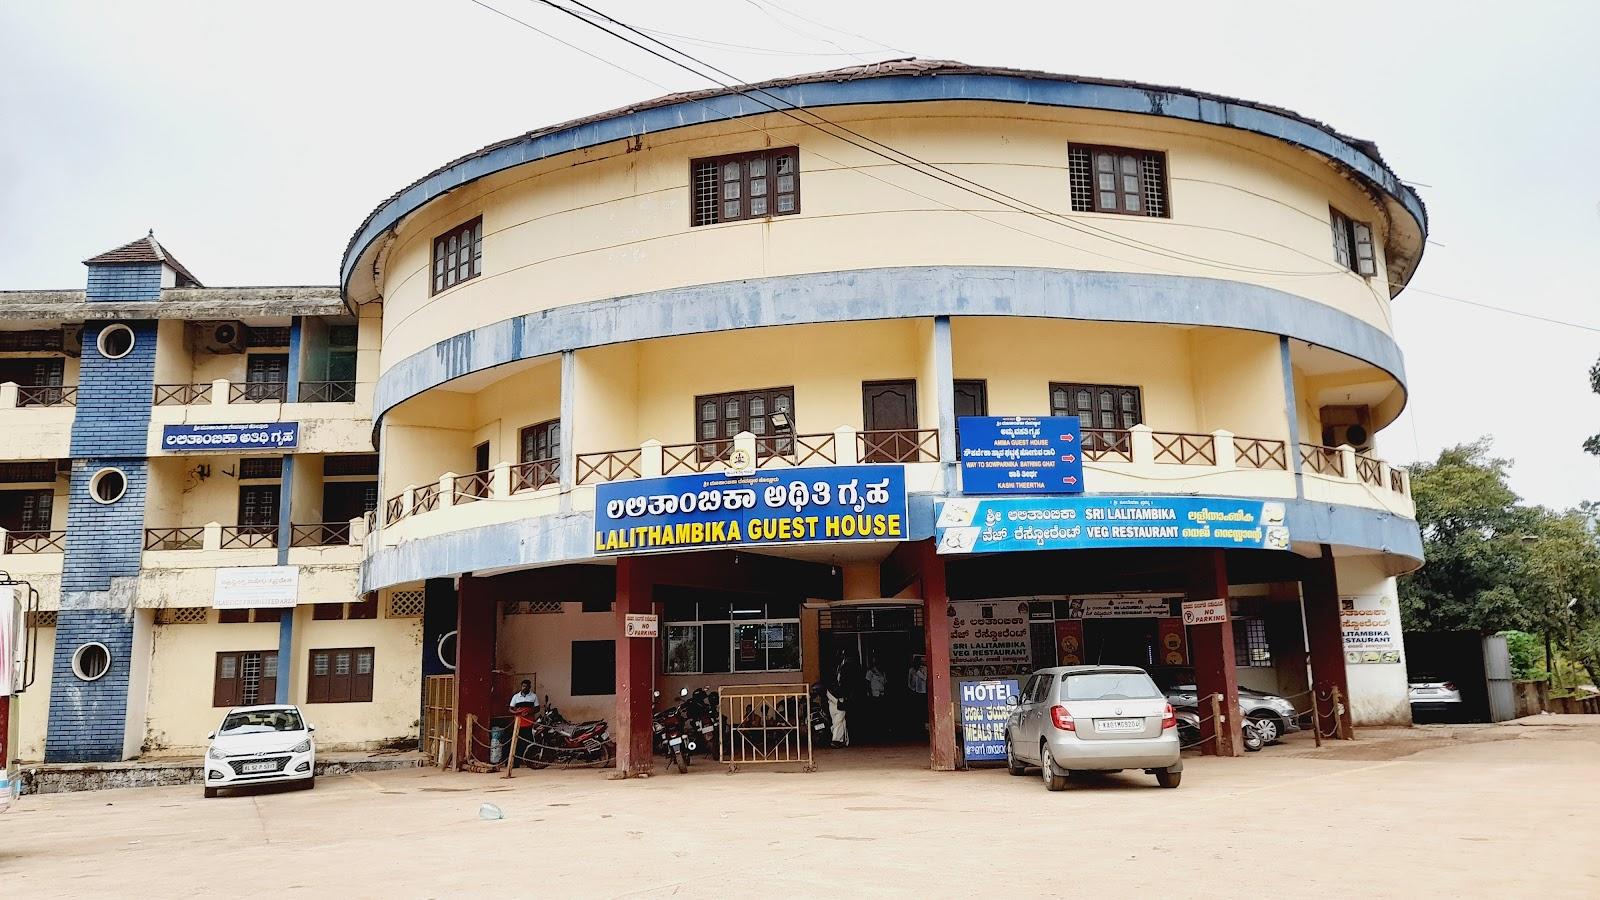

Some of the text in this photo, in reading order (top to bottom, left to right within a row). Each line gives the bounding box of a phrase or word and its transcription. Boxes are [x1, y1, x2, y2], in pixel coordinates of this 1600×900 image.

[606, 486, 756, 519] ಲಲಿತಾಂಬಿಕಾ
[838, 478, 890, 513] ಗೃಹ
[986, 509, 1076, 526] ಶ್ರೀ ಲಲಿತಾಂಬಿಕಾ
[1085, 508, 1176, 521] SRI LALITAMBIKA
[596, 514, 900, 551] LALITHAMBIKA GUEST HOUSE
[1087, 526, 1178, 539] VEG RESTAURANT
[964, 685, 1011, 701] HOTEL
[966, 723, 1007, 741] MEALS RE
